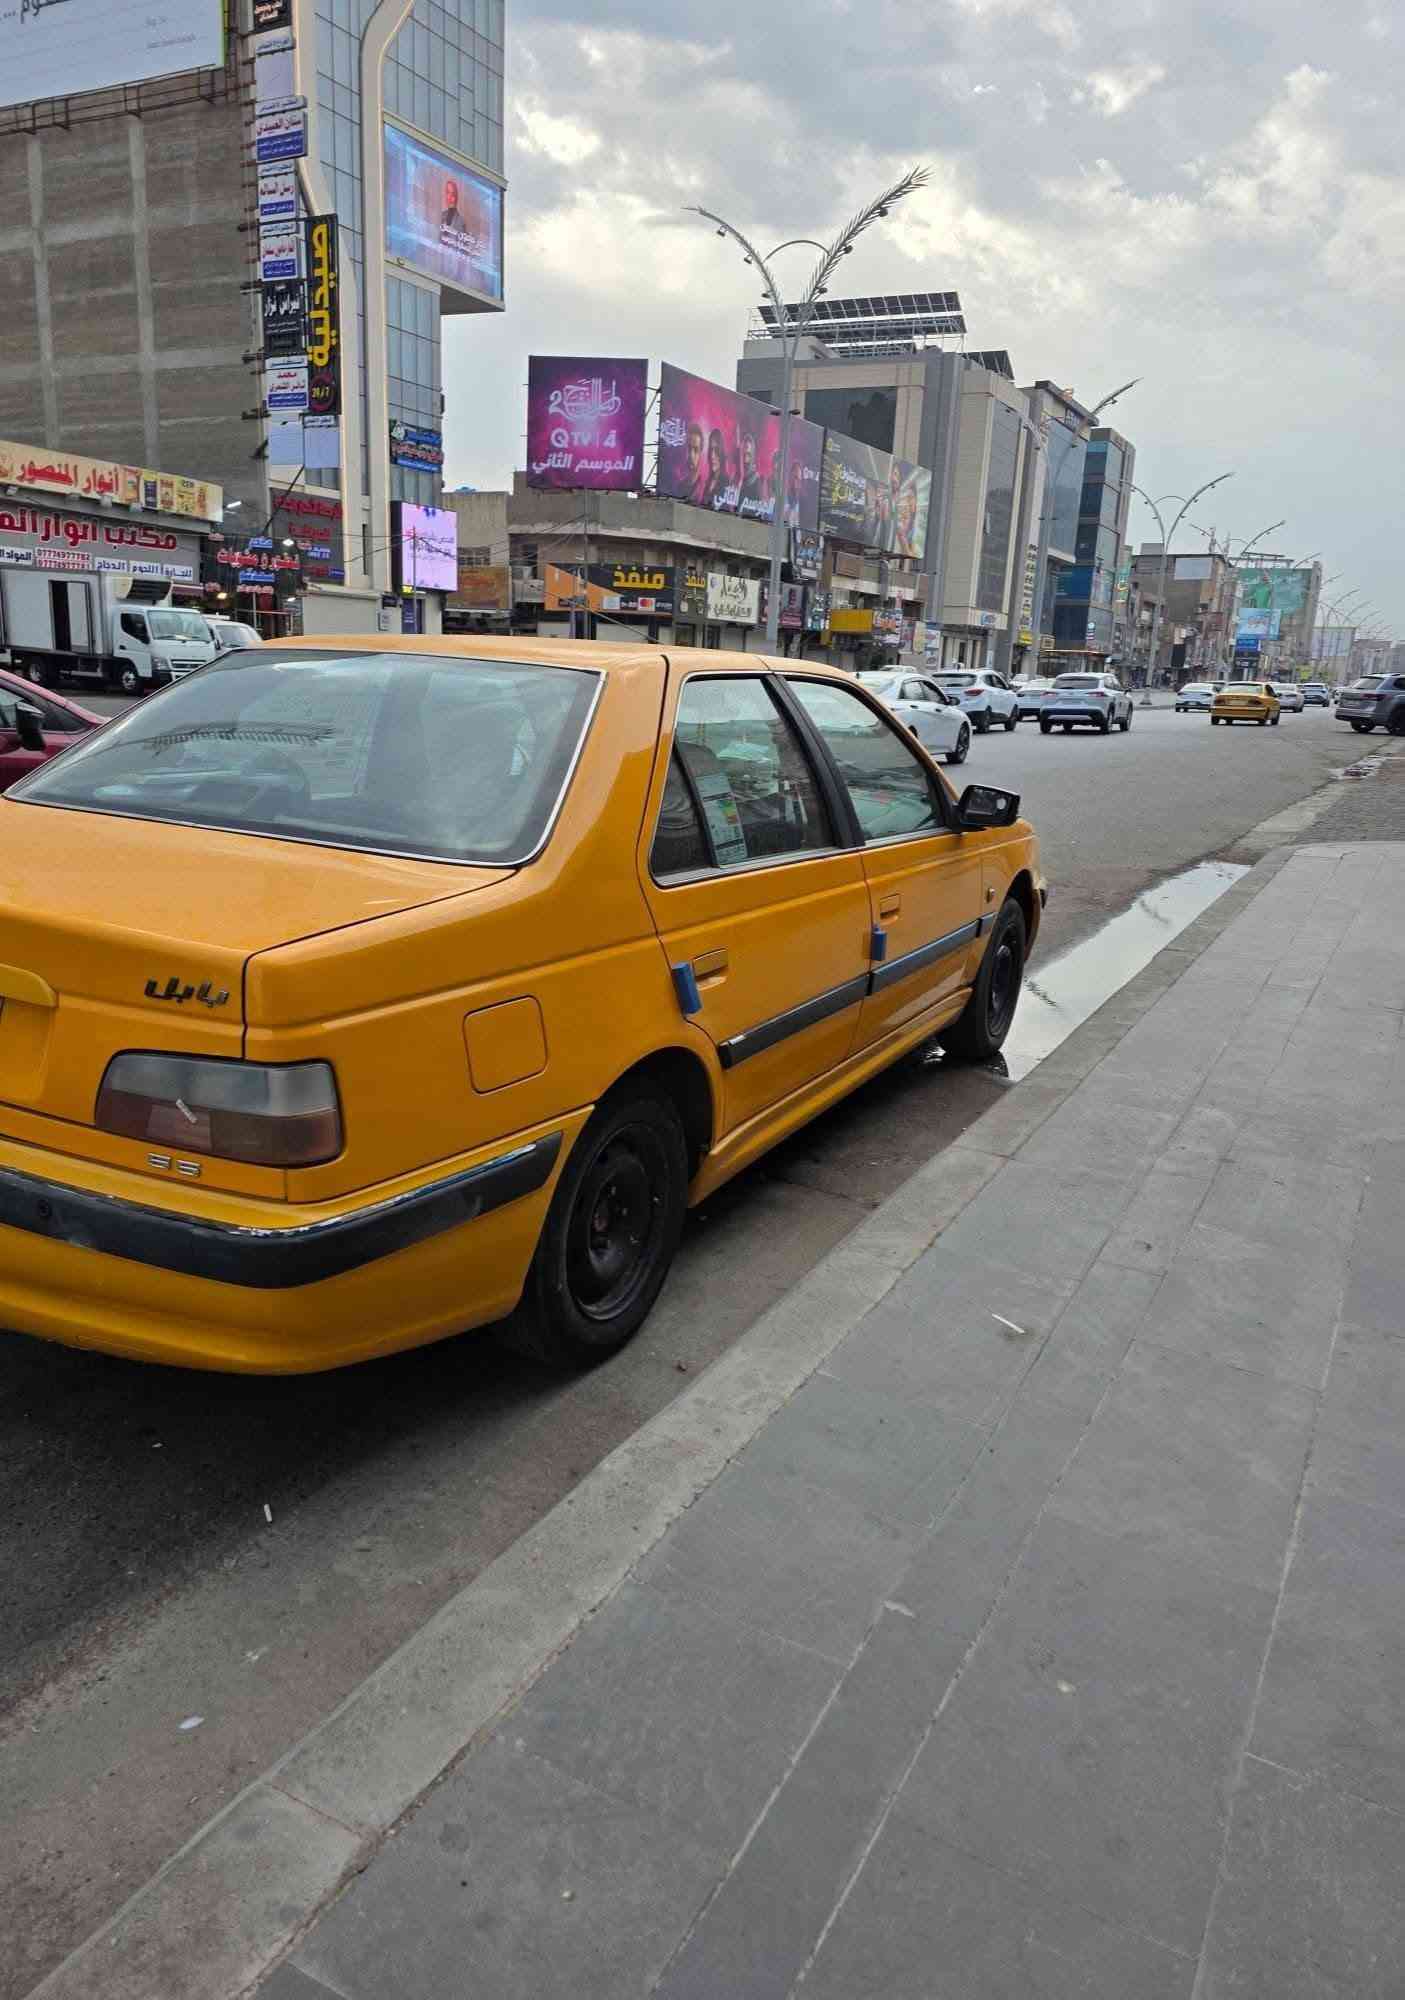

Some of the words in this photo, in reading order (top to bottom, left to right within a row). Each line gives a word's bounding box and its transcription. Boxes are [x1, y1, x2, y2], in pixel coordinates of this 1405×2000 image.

[308, 223, 336, 367] صيدلية
[16, 461, 78, 488] المنصور
[532, 452, 573, 474] الثاني
[575, 455, 635, 473] الموسم
[40, 513, 99, 546] انوار
[104, 523, 177, 550] مكتب
[96, 559, 126, 571] الدجاج
[613, 565, 665, 590] منفذ
[144, 976, 229, 1008] بابل
